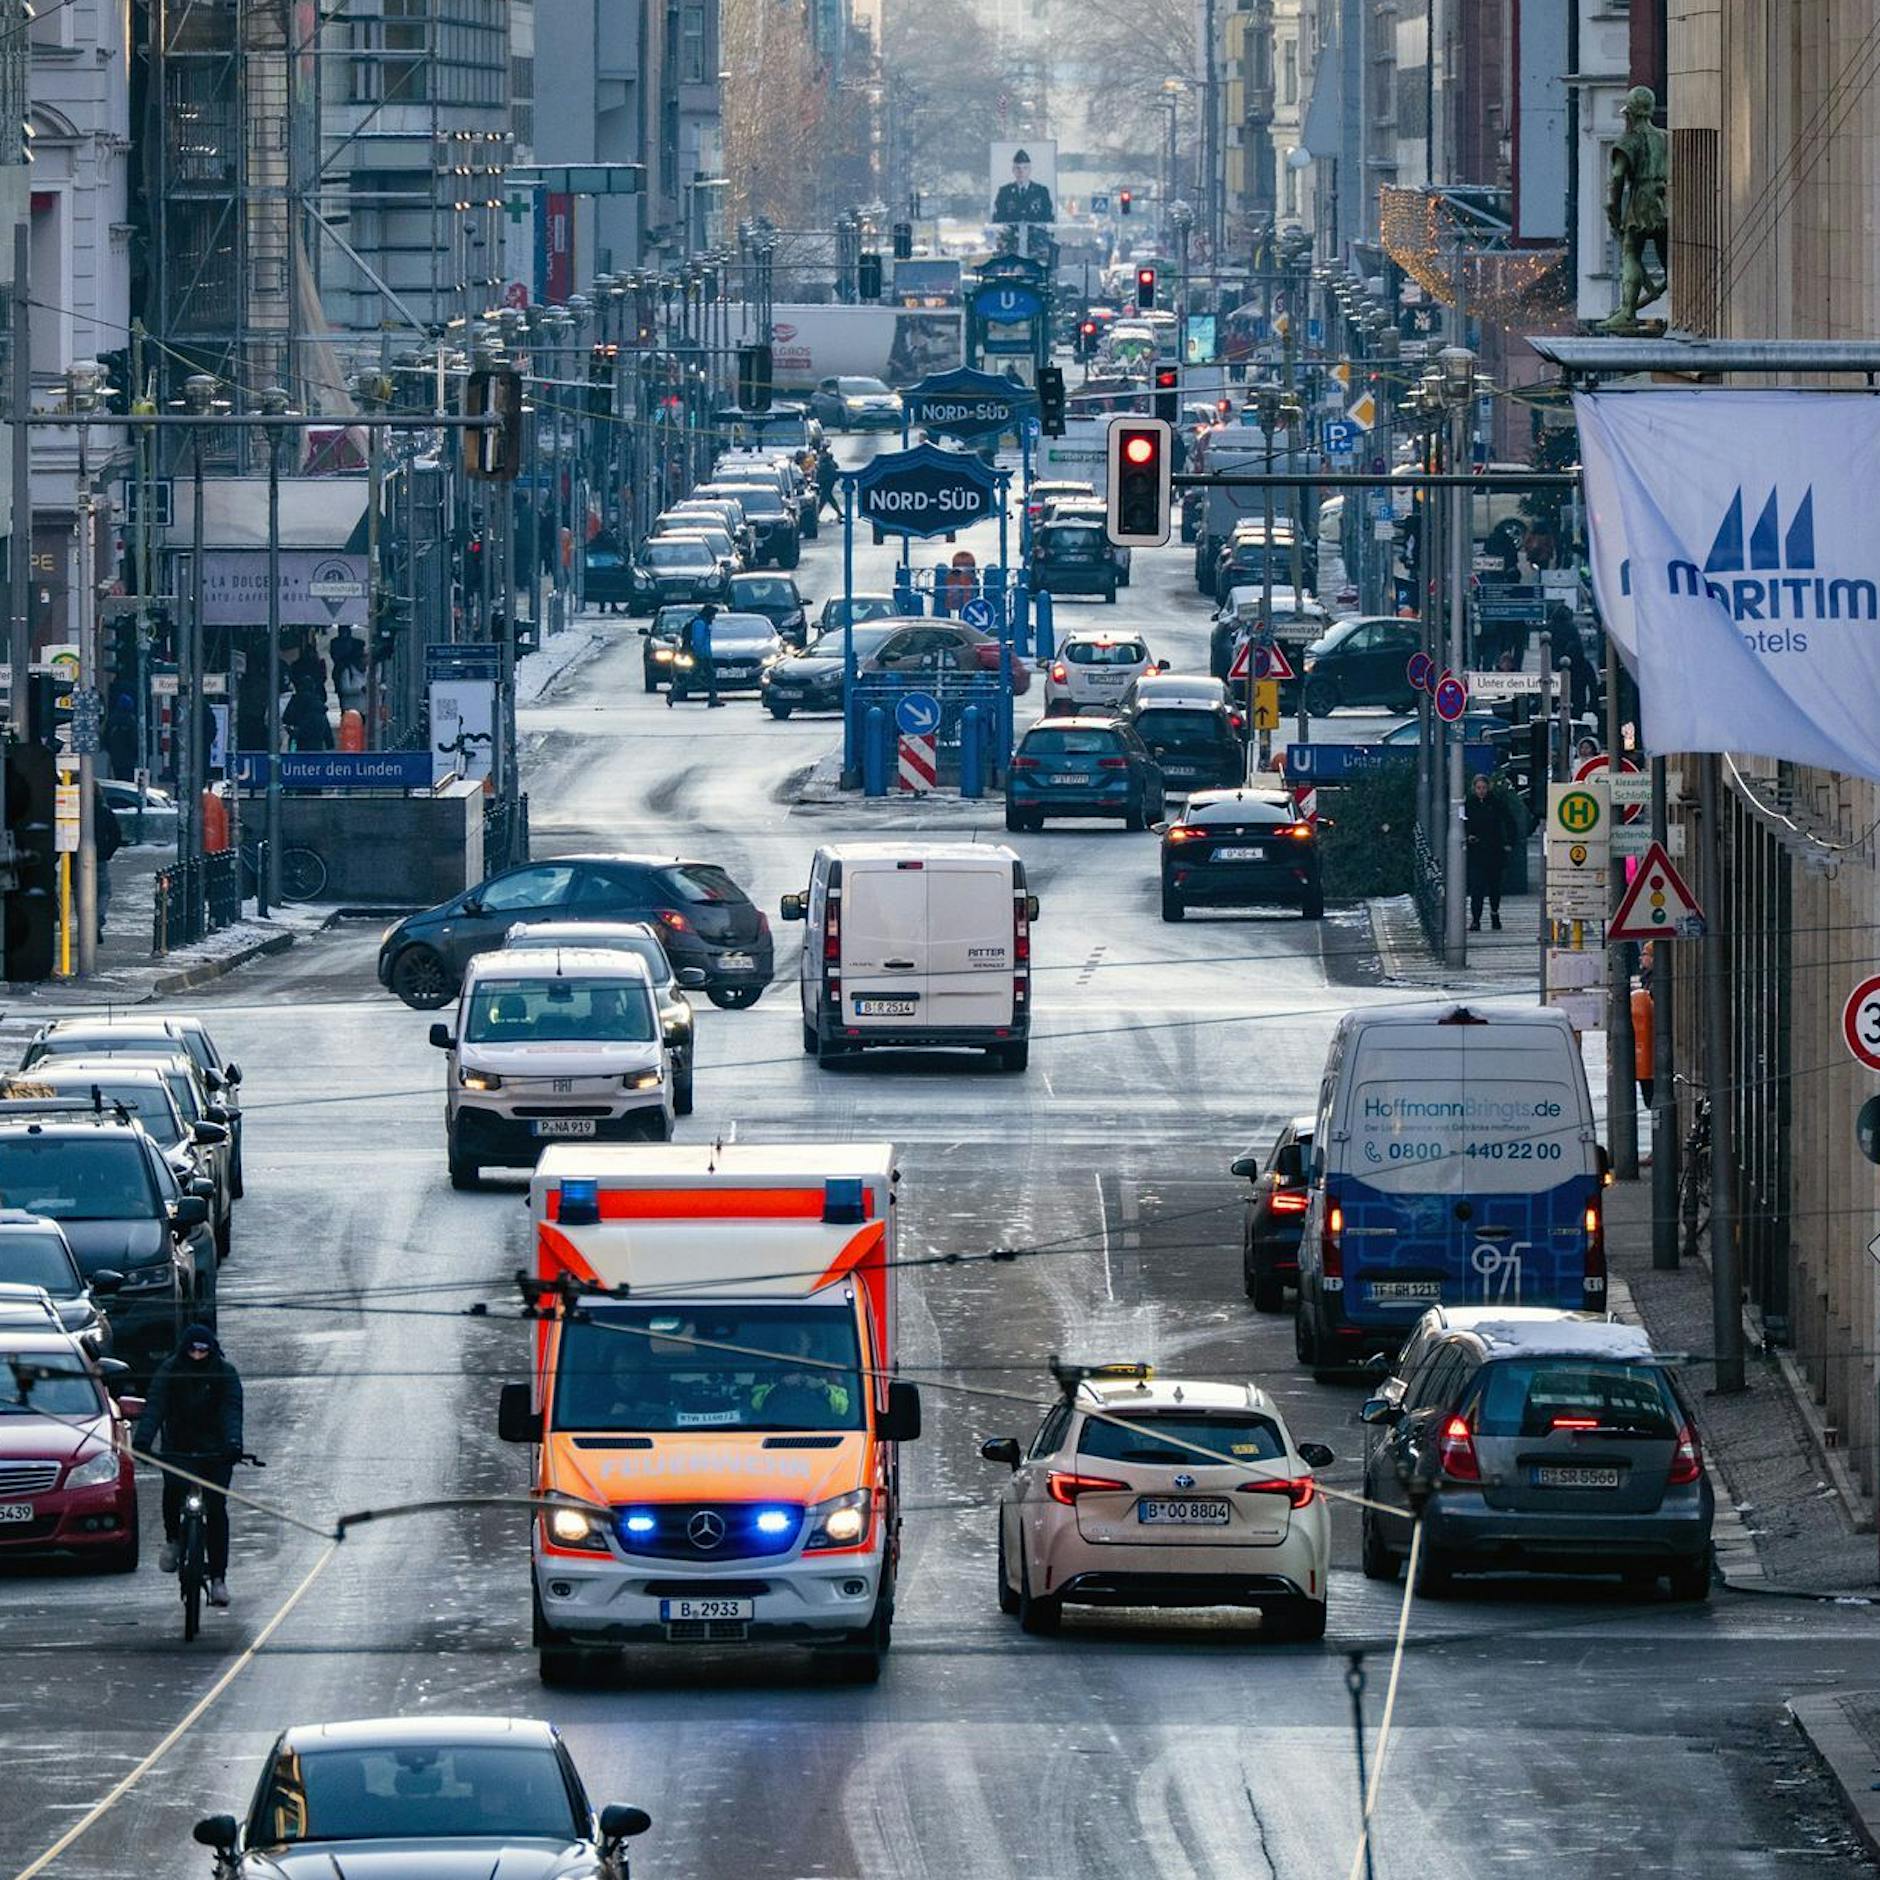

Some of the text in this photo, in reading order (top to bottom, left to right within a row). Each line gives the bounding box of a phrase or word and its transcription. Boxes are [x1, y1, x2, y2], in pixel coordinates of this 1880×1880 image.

[922, 402, 1009, 420] NORD-SÜD
[869, 487, 980, 510] NORD-SÜD
[211, 576, 225, 588] LA
[1477, 678, 1503, 689] Unter
[1507, 677, 1525, 689] den
[282, 762, 320, 776] Unter
[326, 761, 351, 776] den
[356, 761, 403, 776] Linden
[1293, 750, 1311, 771] U
[1569, 802, 1588, 824] H
[968, 948, 1005, 957] RITTER
[552, 1079, 573, 1093] FIAT
[1365, 1098, 1561, 1122] HoffmannBringts.de
[571, 1121, 591, 1132] 919
[1389, 1143, 1442, 1160] 0800
[1464, 1143, 1503, 1160] 440
[1507, 1143, 1532, 1160] 22
[1537, 1143, 1561, 1160] 00
[602, 1453, 812, 1479] FEUERWEHR
[1149, 1503, 1158, 1517] B
[1190, 1502, 1227, 1518] 8804
[681, 1602, 739, 1617] B 2933
